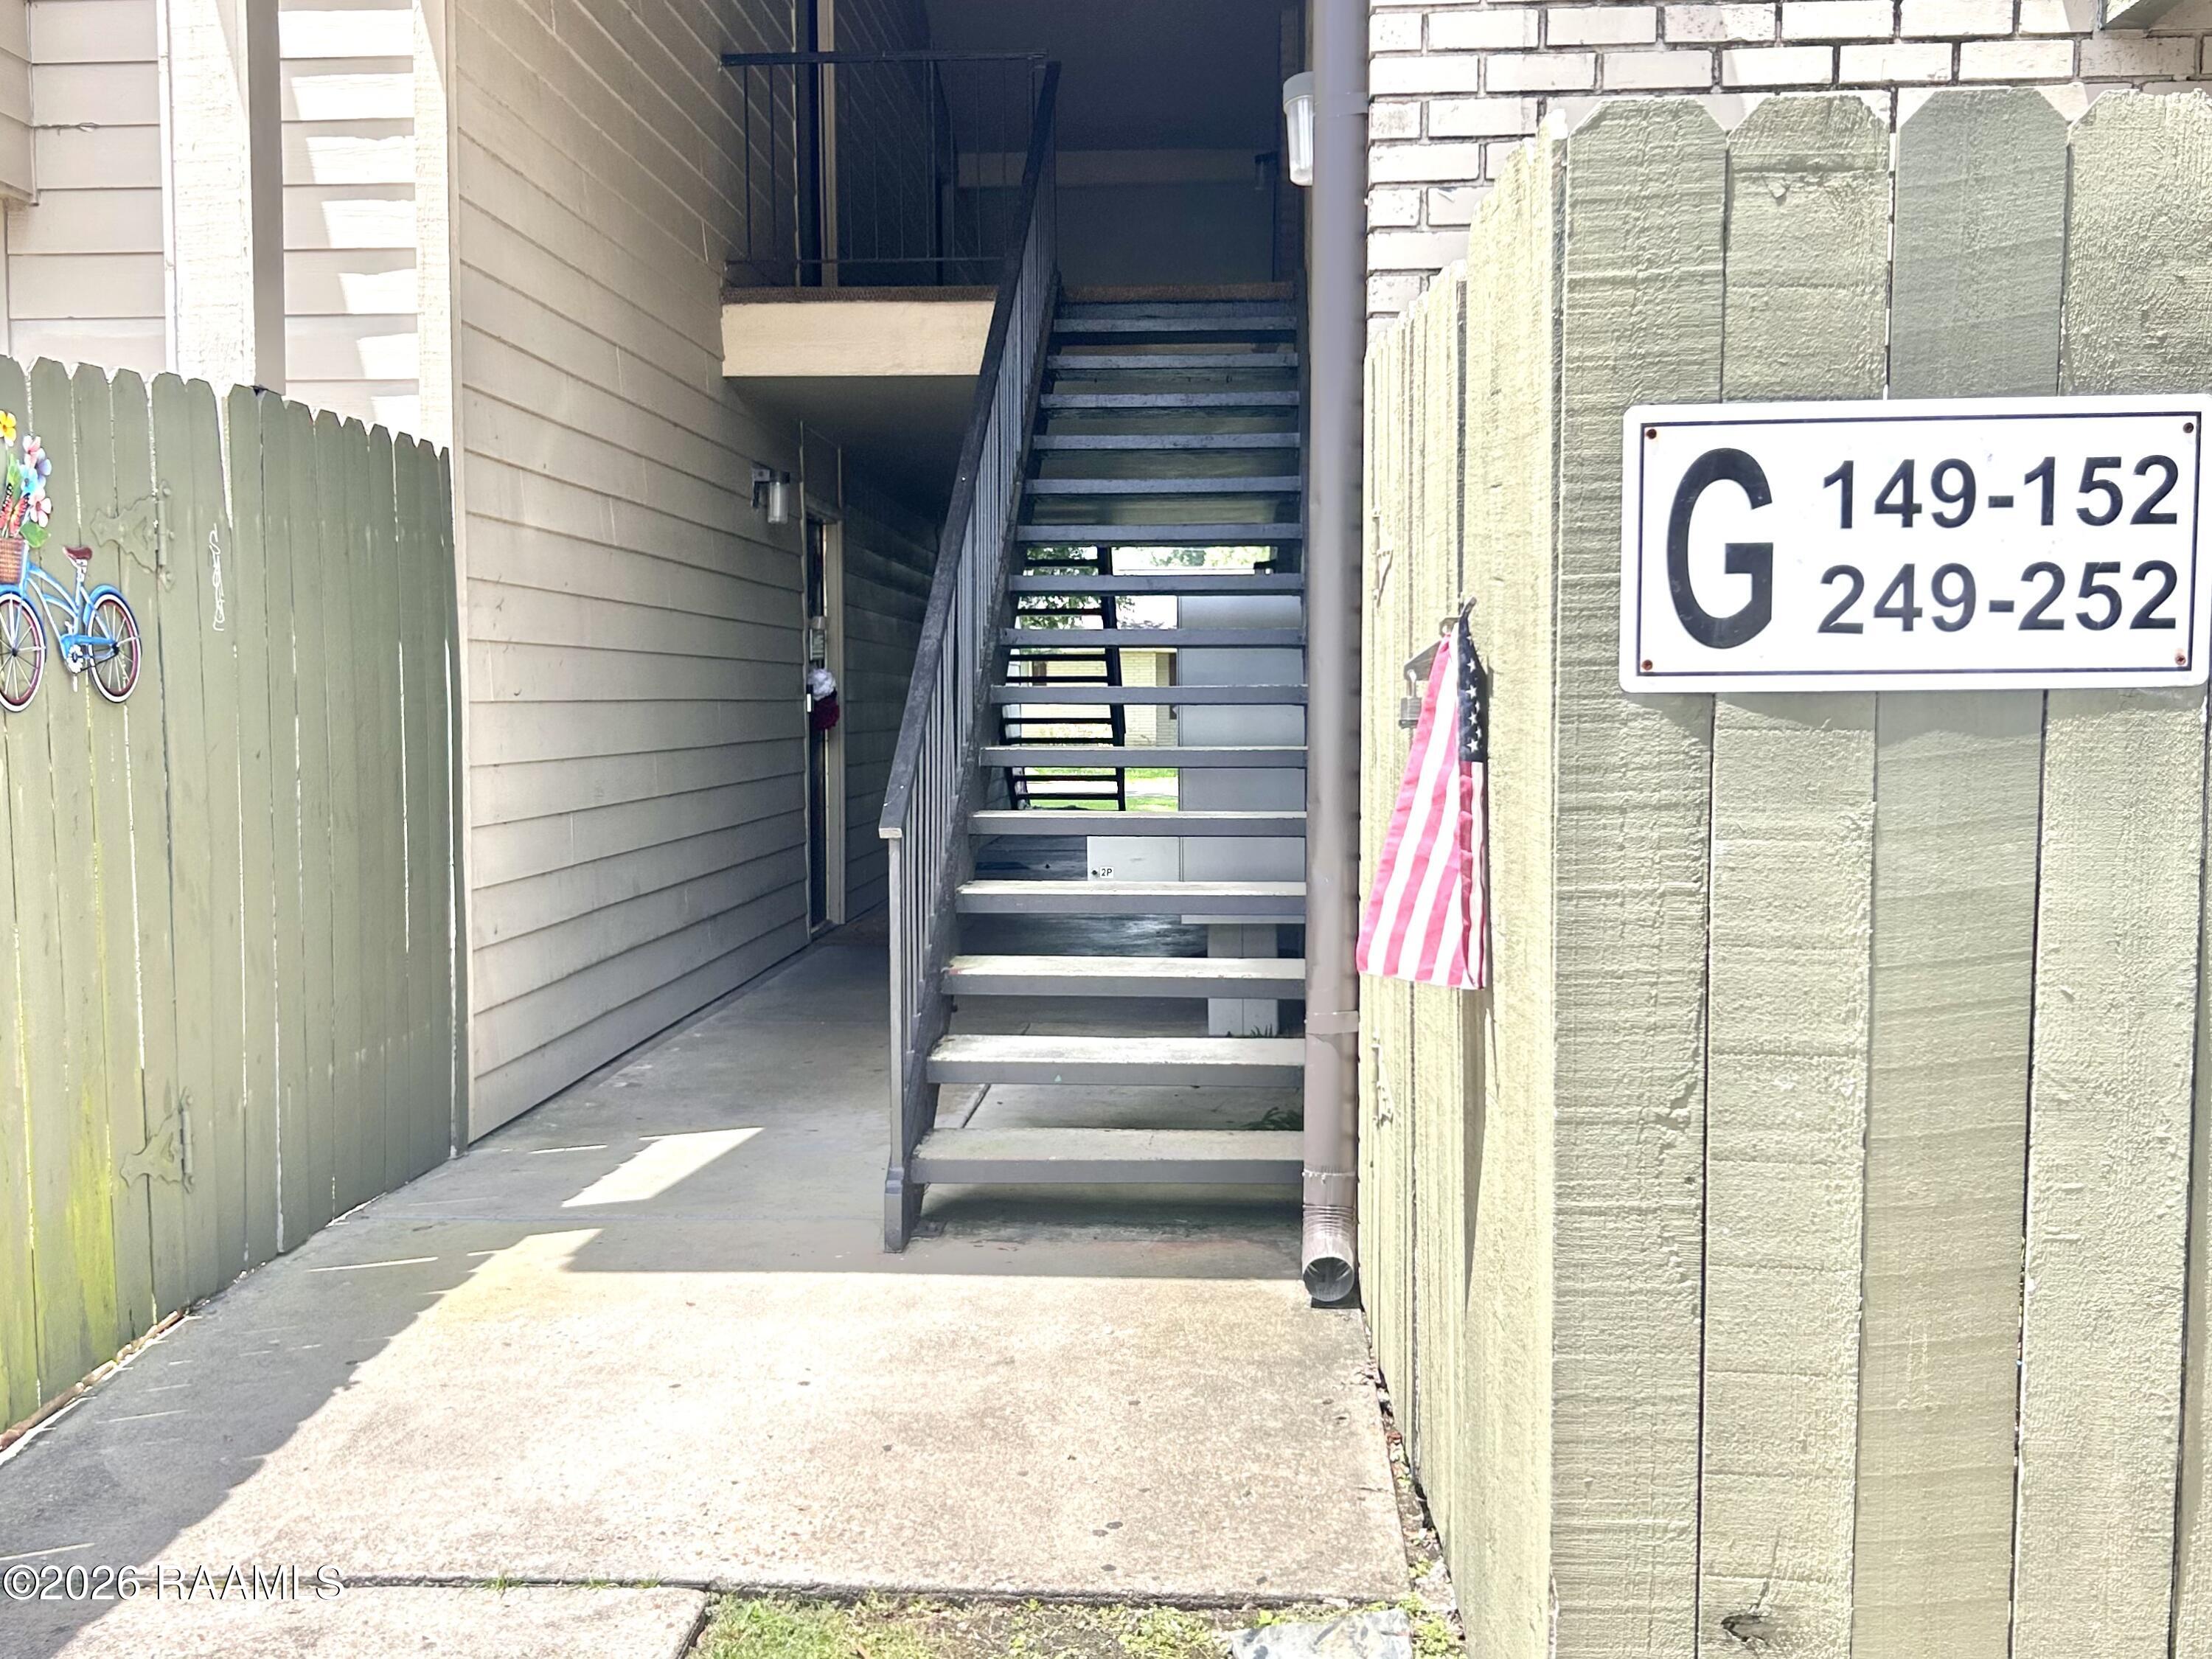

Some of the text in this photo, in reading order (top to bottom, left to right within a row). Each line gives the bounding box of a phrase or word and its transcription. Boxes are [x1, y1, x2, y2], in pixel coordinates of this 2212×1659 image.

[1823, 454, 2180, 529] 149-152
[1666, 448, 1774, 650] G
[1817, 560, 2179, 634] 249-252
[1101, 868, 1113, 877] 2P
